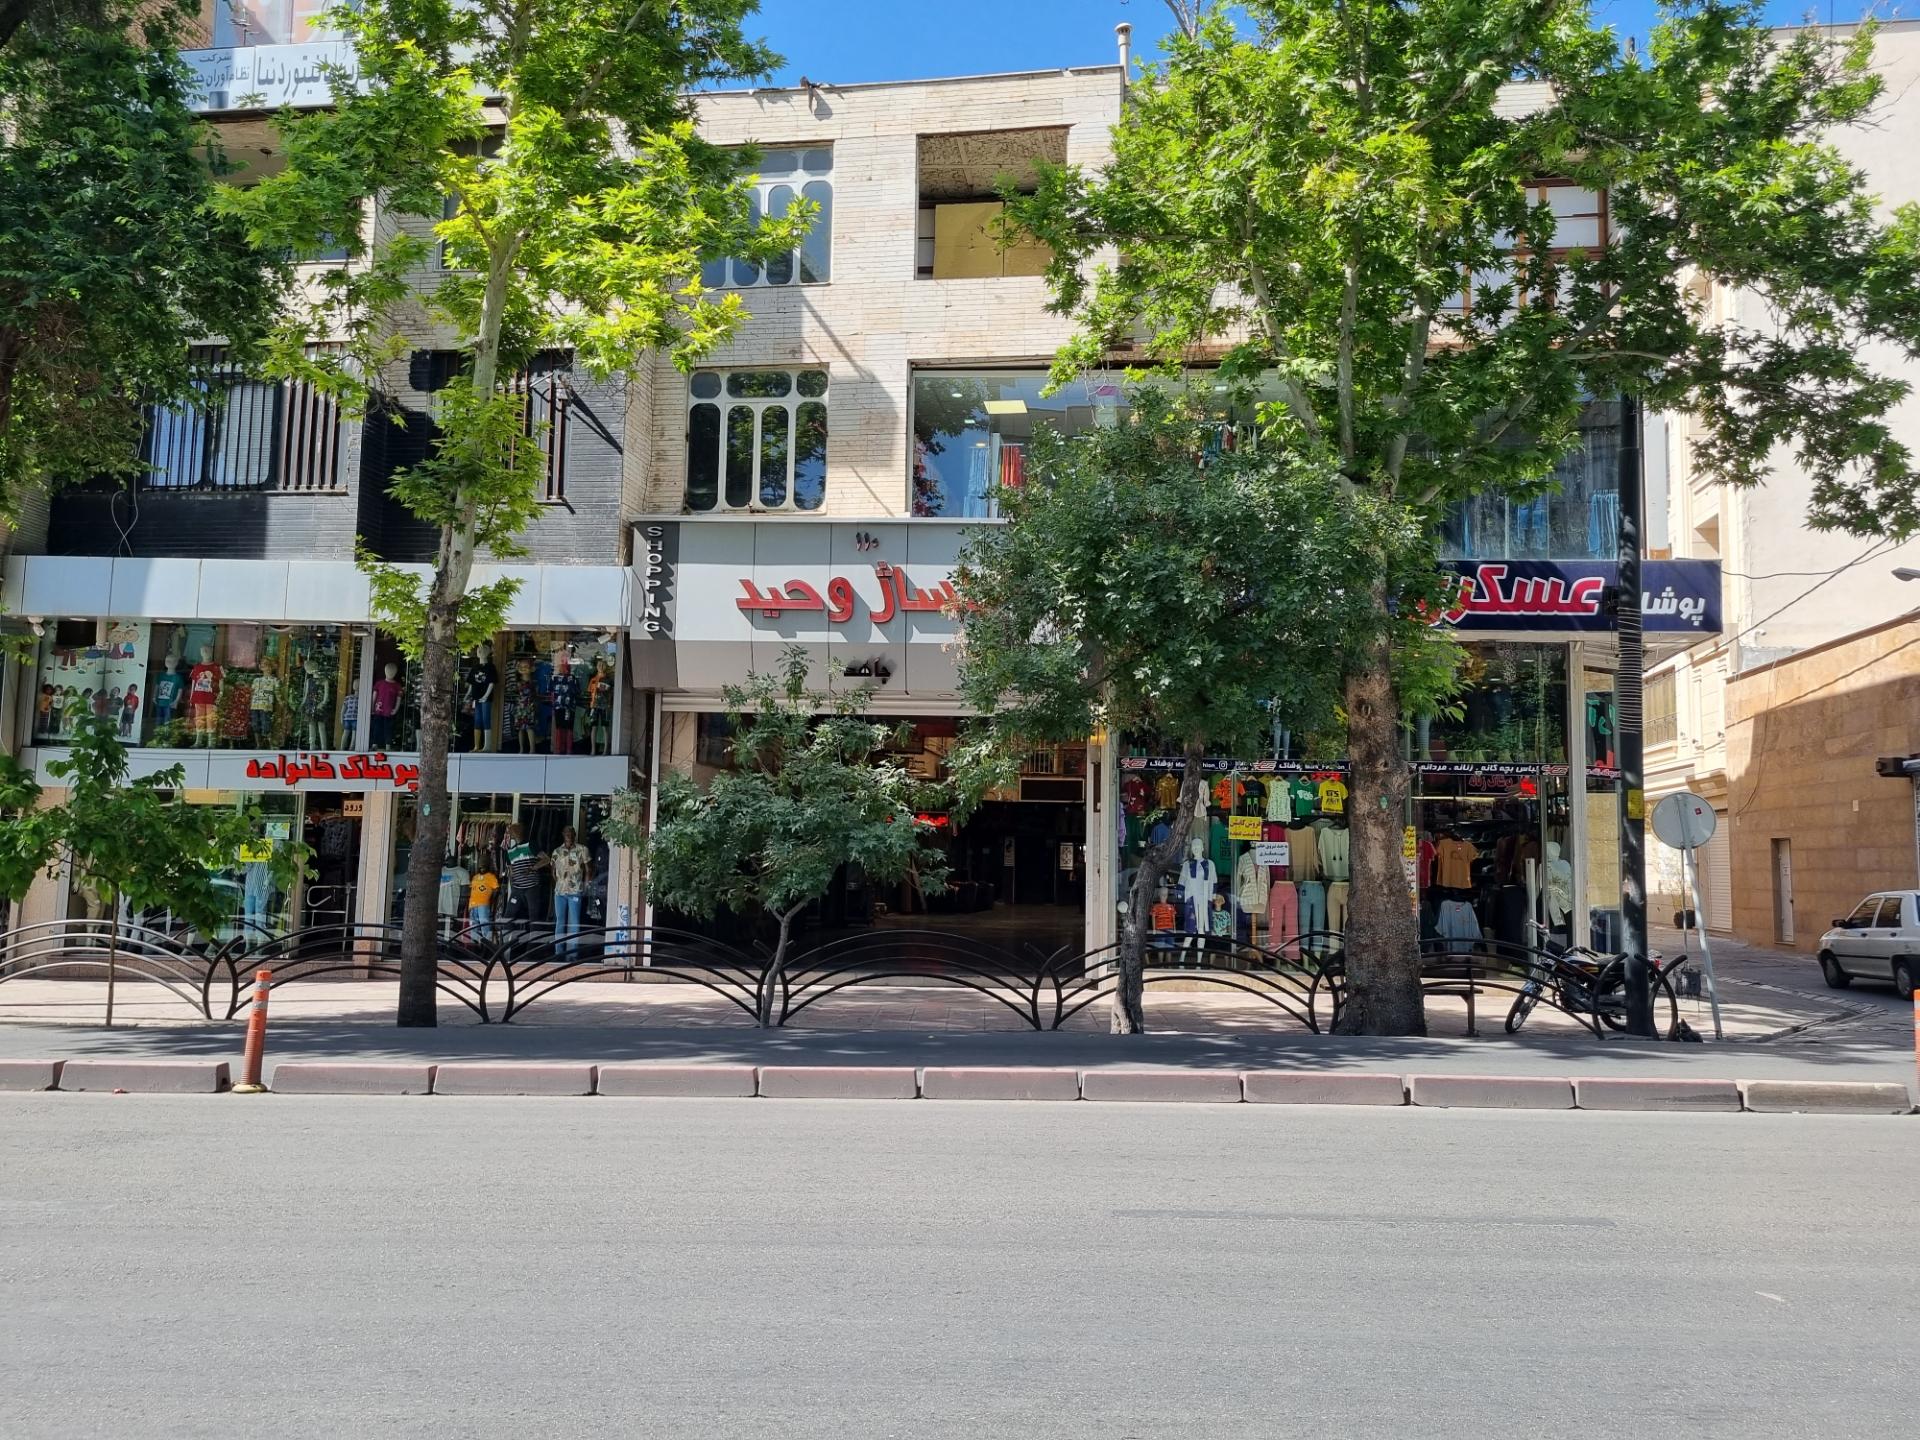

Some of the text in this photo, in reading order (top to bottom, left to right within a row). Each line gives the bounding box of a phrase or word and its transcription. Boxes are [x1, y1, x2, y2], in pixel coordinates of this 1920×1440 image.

[643, 525, 664, 634] SHOPPING
[735, 576, 854, 623] وحید
[246, 752, 421, 792] پوشاک خانواده
